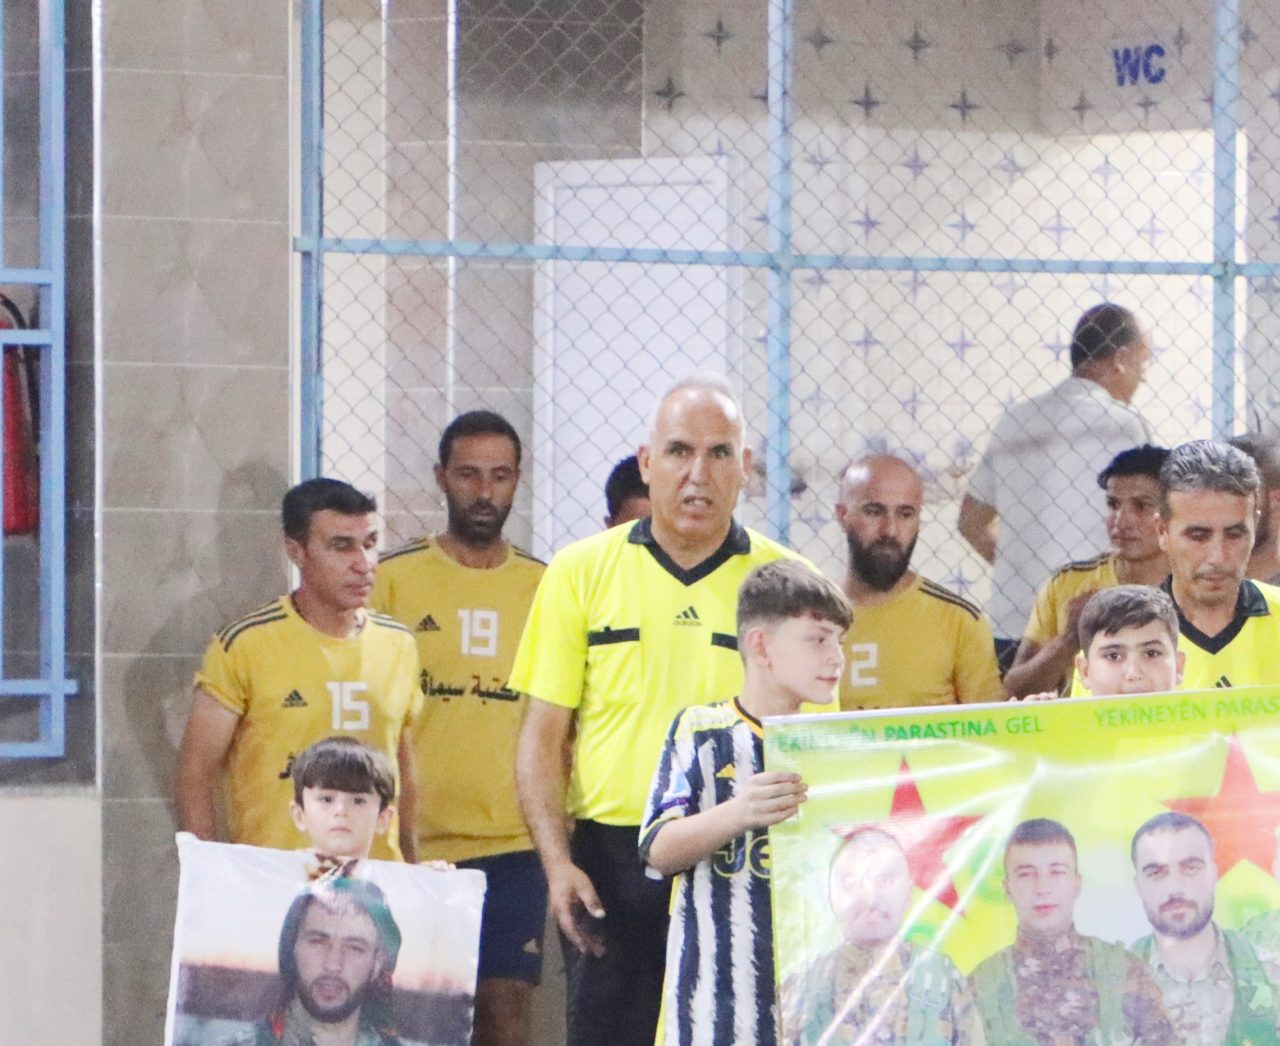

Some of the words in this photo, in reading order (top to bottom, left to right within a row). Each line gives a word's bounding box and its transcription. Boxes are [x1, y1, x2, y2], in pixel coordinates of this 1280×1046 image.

[1113, 45, 1165, 87] WC
[457, 608, 498, 656] 19
[326, 681, 370, 730] 15
[884, 720, 997, 741] PARASTINA
[1006, 715, 1044, 735] GEL
